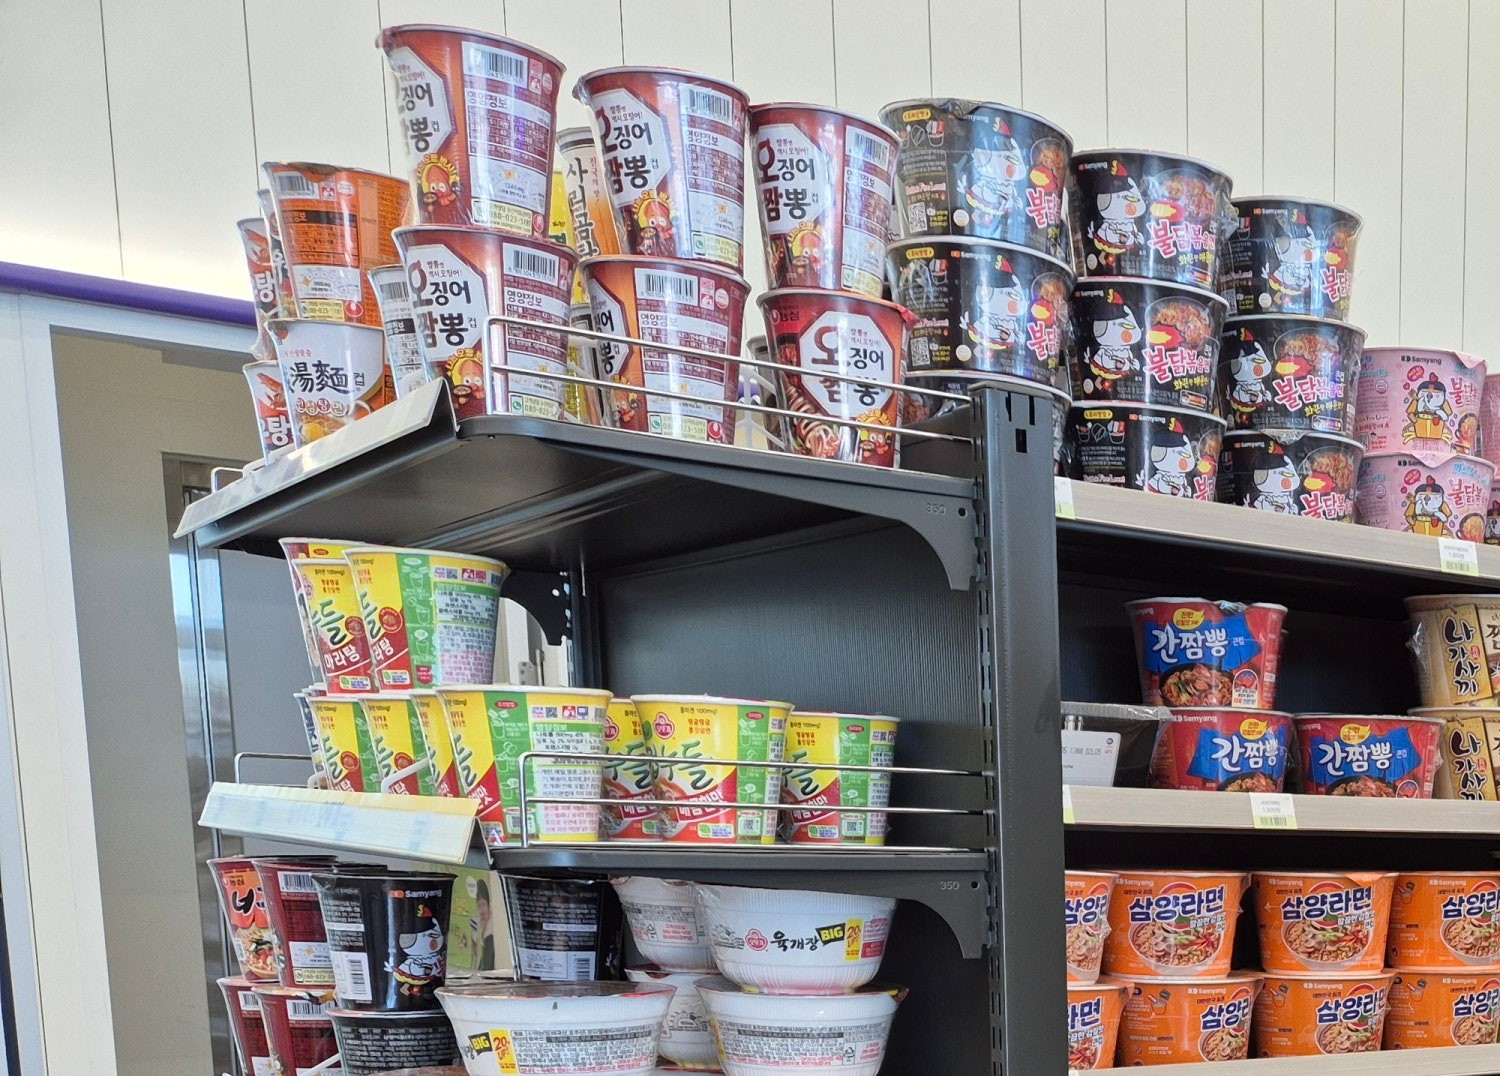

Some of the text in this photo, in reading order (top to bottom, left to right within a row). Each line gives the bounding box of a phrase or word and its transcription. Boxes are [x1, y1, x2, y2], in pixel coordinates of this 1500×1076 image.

[598, 107, 653, 154] 오징어
[757, 138, 815, 183] 오징어
[763, 188, 811, 222] 짬뽕
[408, 260, 471, 308] 오징어
[507, 290, 543, 307] 영양정보
[417, 311, 468, 348] 짬뽕
[811, 326, 884, 371] 오징어
[1143, 346, 1210, 383] 불닭볶음면
[1412, 356, 1441, 364] Samyang
[1273, 375, 1345, 411] 불닭볶음면
[324, 644, 360, 670] 마라탕
[1152, 627, 1229, 664] 간짬뽕
[1443, 616, 1480, 694] 나가사끼
[1183, 714, 1217, 723] Samyang
[1212, 736, 1278, 773] 간짬뽕
[1319, 739, 1392, 774] 간짬뽕
[405, 889, 442, 898] Samyang
[1129, 886, 1224, 922] 삼양라면
[1281, 886, 1372, 920] 삼양라면
[771, 927, 844, 951] 육개장 BIG
[472, 1035, 490, 1051] BIG
